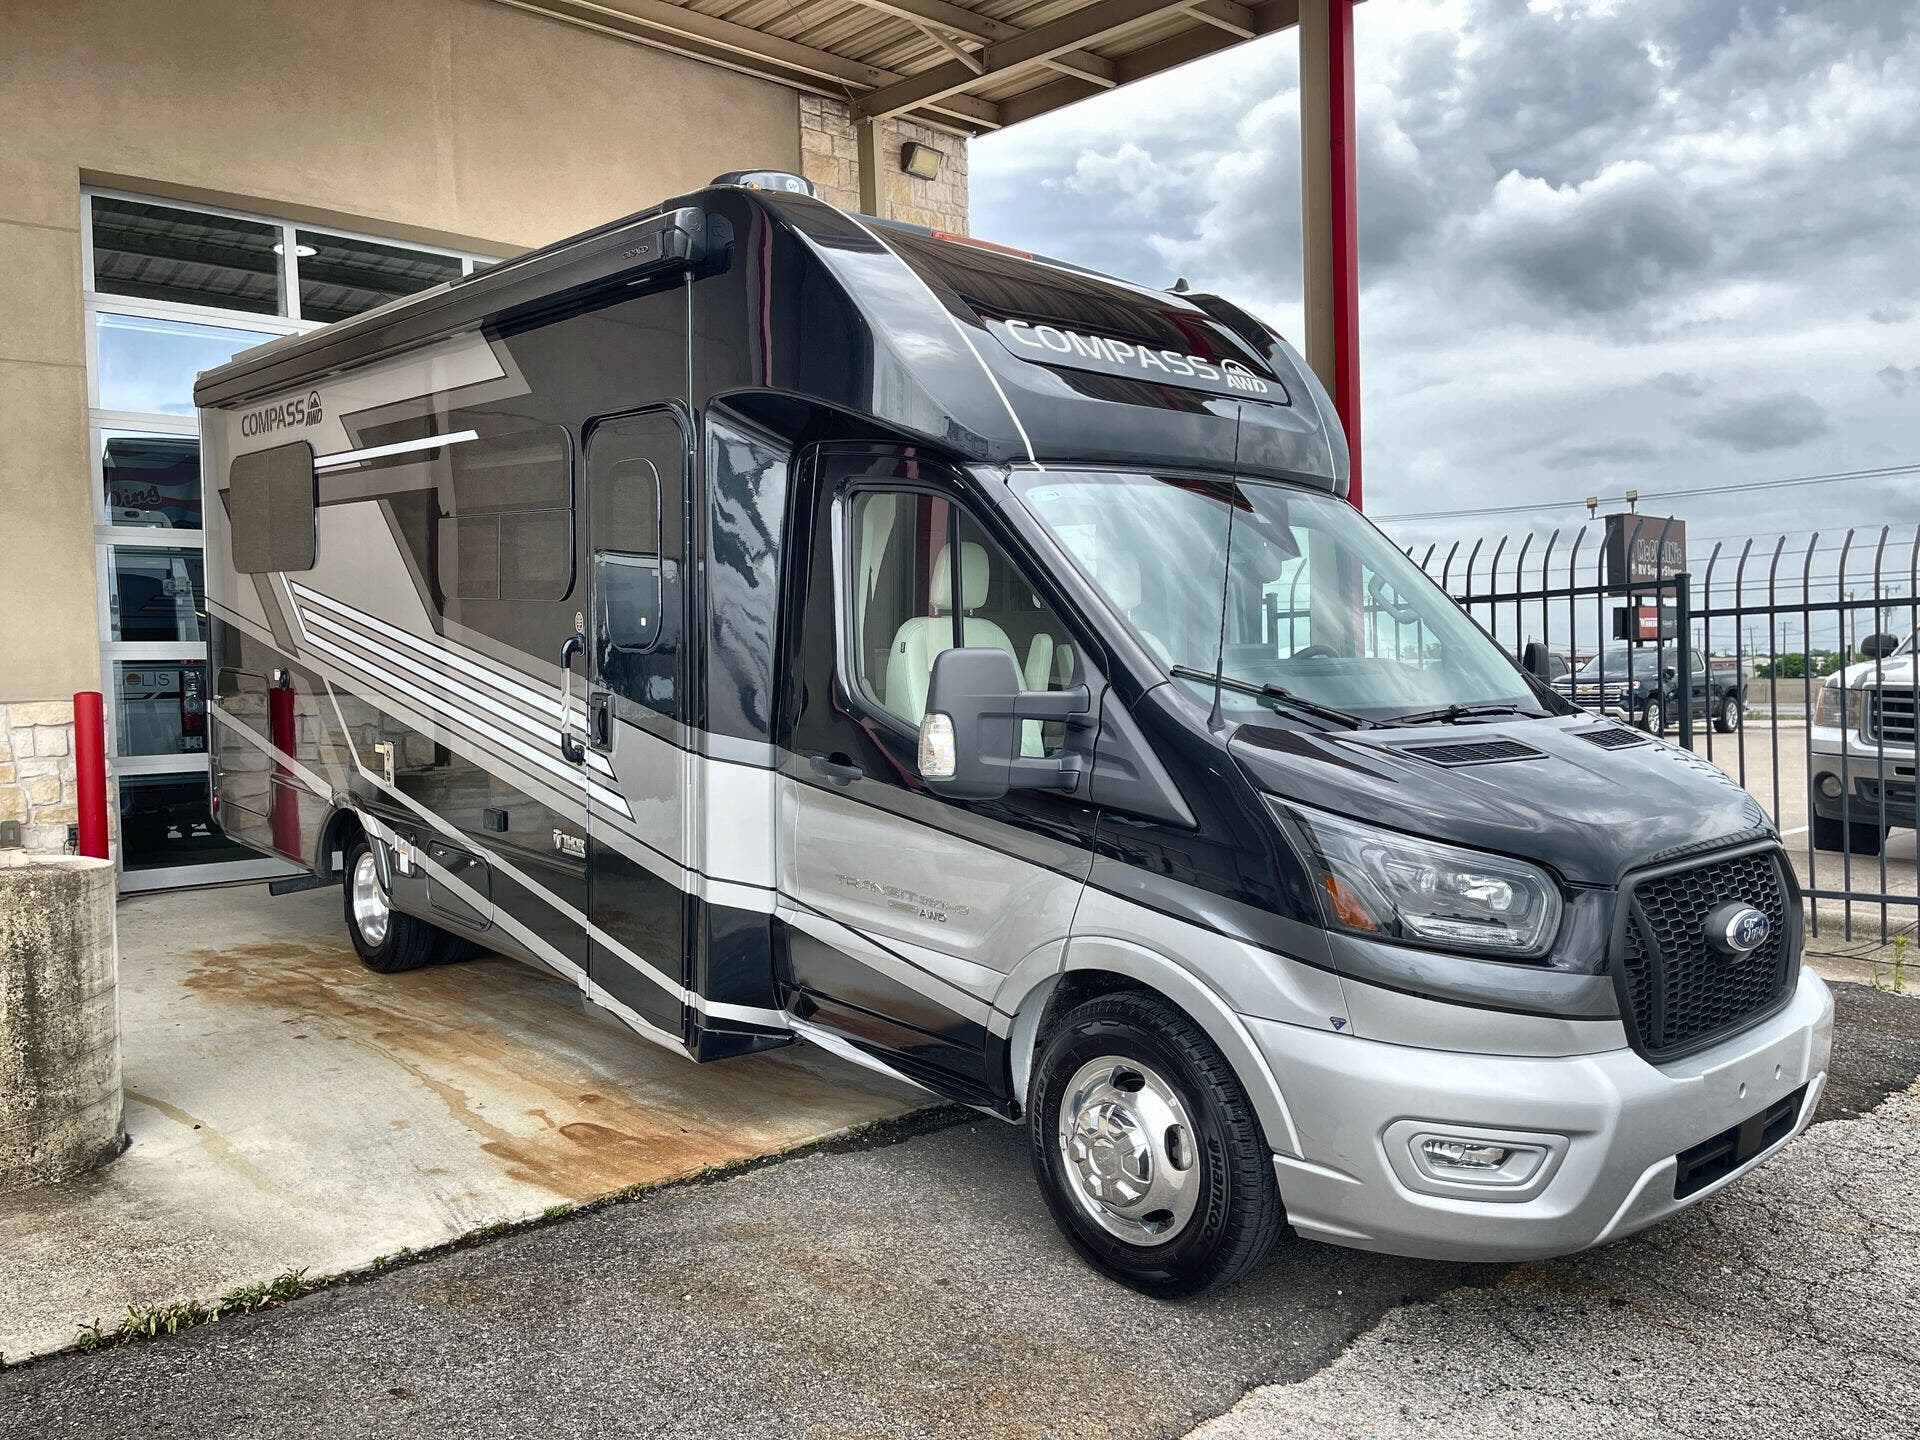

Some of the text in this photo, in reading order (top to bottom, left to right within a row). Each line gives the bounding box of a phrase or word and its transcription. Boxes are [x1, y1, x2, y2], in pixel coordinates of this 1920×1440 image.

[1004, 319, 1220, 381] COMPASS
[1226, 373, 1268, 394] AWD
[241, 399, 305, 437] COMPASS
[305, 407, 323, 427] AWD
[919, 908, 948, 923] AWD
[1743, 917, 1765, 943] Ford
